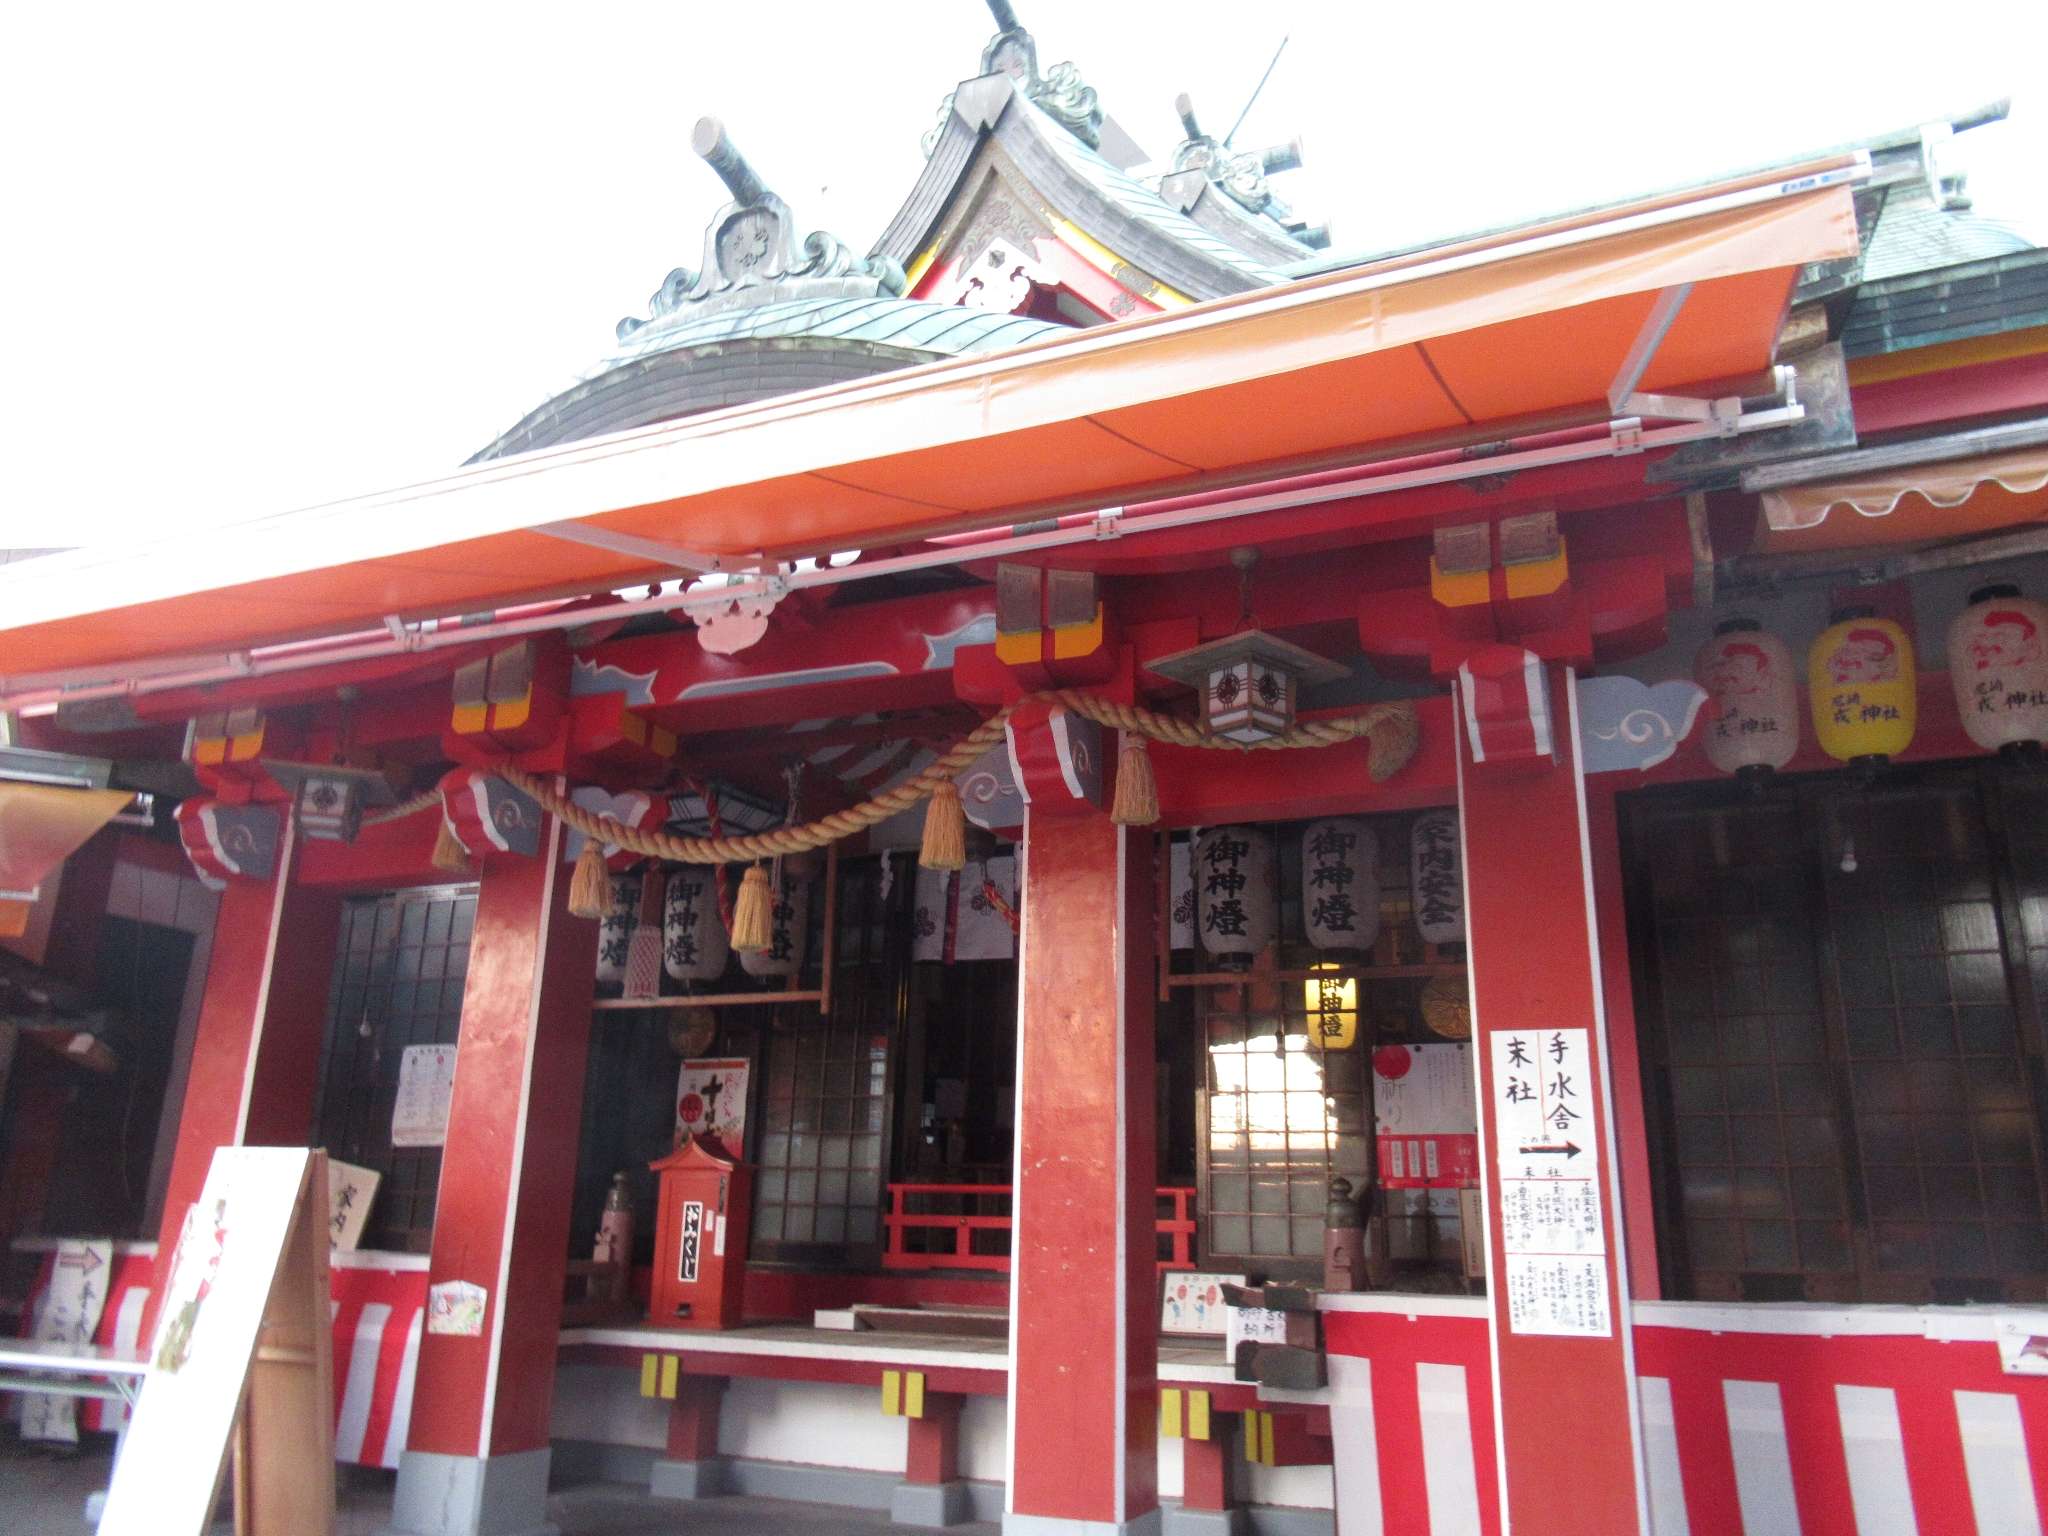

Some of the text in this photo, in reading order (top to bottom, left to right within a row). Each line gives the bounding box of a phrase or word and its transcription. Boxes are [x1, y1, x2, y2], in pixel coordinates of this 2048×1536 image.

[666, 878, 703, 966] 御神燈
[1204, 834, 1250, 937] 御神燈
[1310, 826, 1356, 932] 御神燈
[1415, 818, 1461, 926] 家内安全
[1505, 1037, 1538, 1104] 末社
[1547, 1031, 1581, 1130] 手水舎
